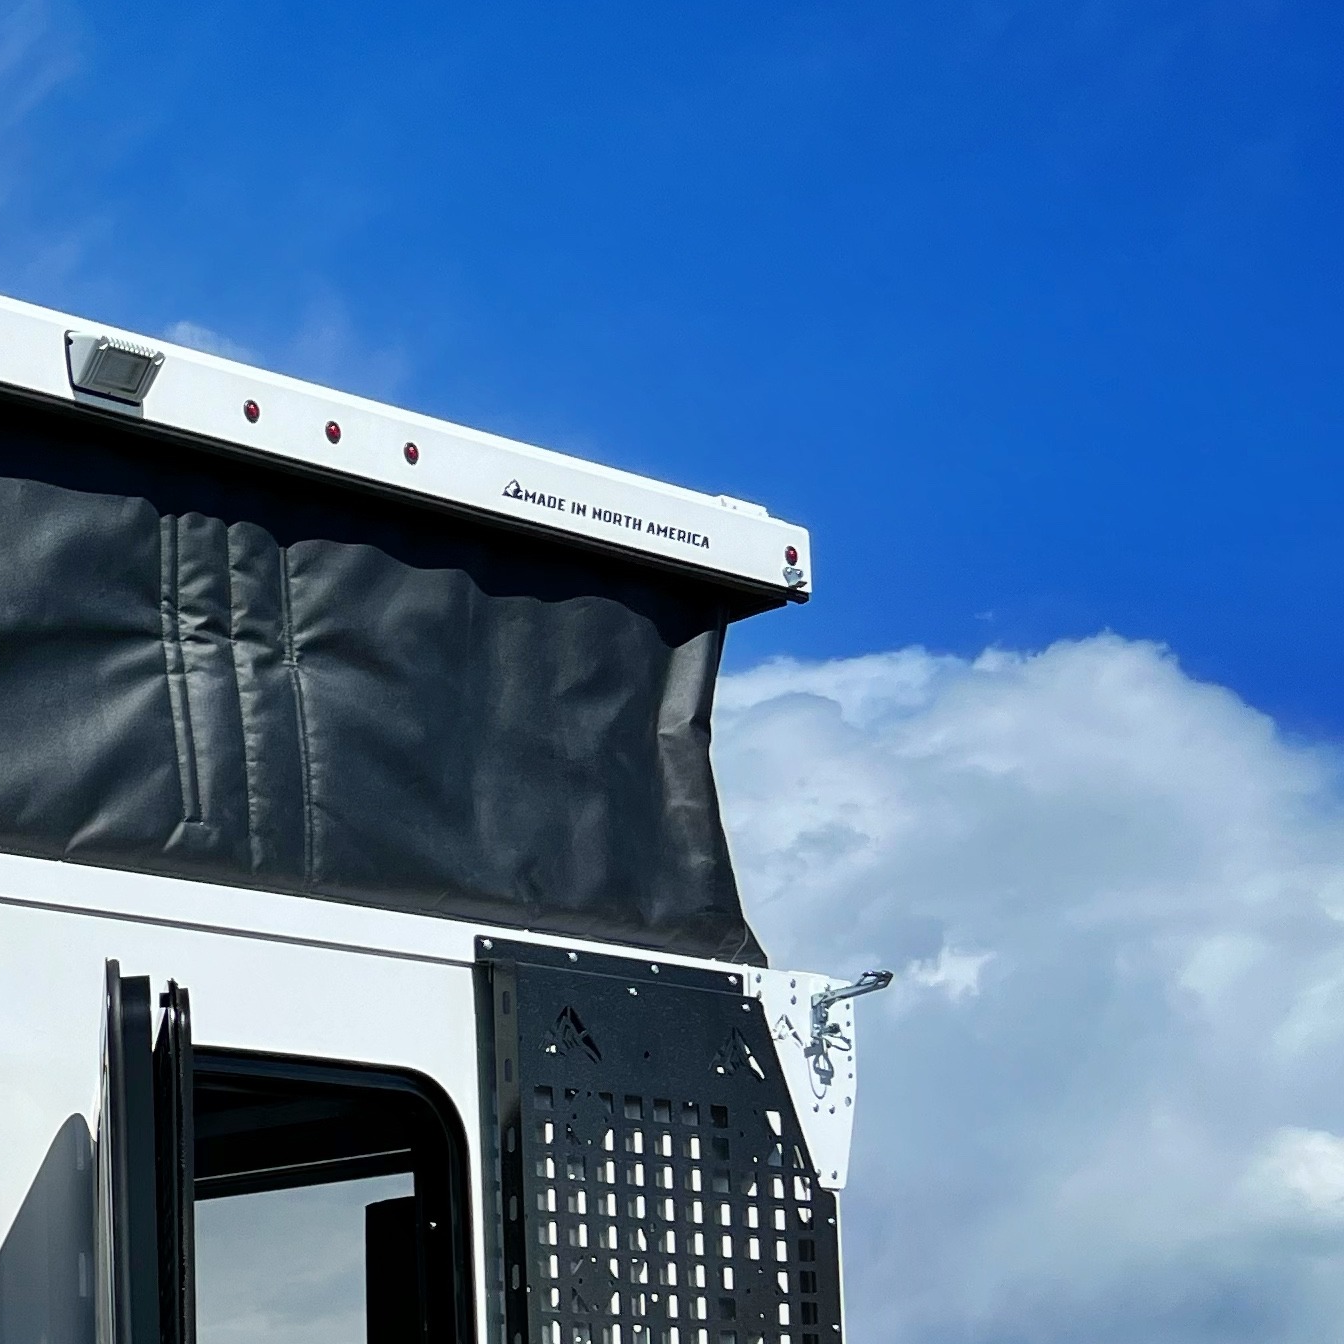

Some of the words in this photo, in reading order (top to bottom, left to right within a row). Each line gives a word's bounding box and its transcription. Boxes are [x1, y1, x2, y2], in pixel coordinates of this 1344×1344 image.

[523, 488, 566, 511] MADE
[571, 500, 587, 517] IN
[592, 507, 642, 531] NORTH
[646, 521, 710, 549] AMERICA
